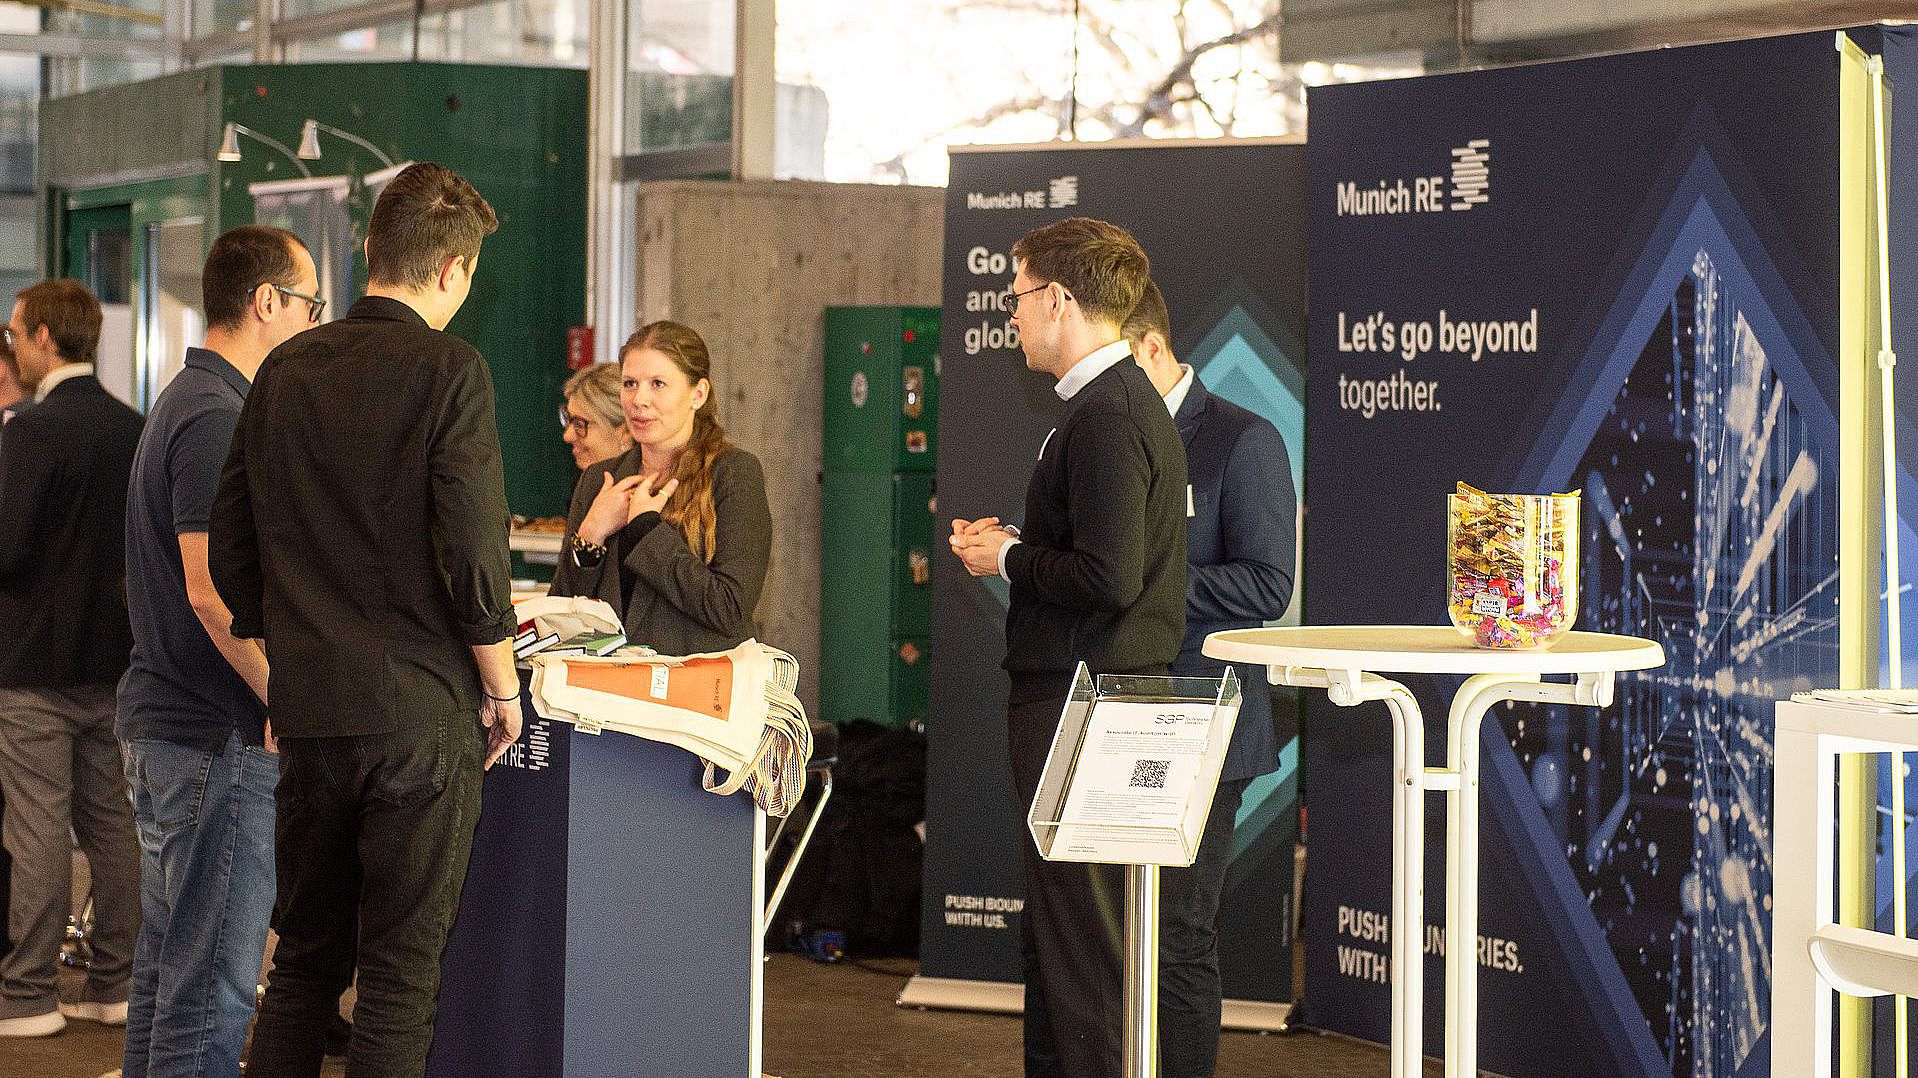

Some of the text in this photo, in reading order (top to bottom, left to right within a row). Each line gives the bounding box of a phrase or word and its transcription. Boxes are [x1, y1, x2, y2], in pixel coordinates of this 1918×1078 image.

[967, 190, 1046, 209] Munich RE
[1337, 176, 1443, 216] Munich RE
[967, 246, 1006, 274] Go
[965, 321, 1021, 355] glob
[1401, 321, 1433, 361] go
[1439, 308, 1538, 362] beyond
[1339, 368, 1441, 419] together.
[1155, 714, 1185, 725] SGP
[510, 743, 525, 768] RE
[944, 912, 983, 926] WITH
[945, 895, 1025, 912] PUSH BOUN
[1338, 905, 1388, 944] PUSH
[1338, 945, 1387, 984] WITH
